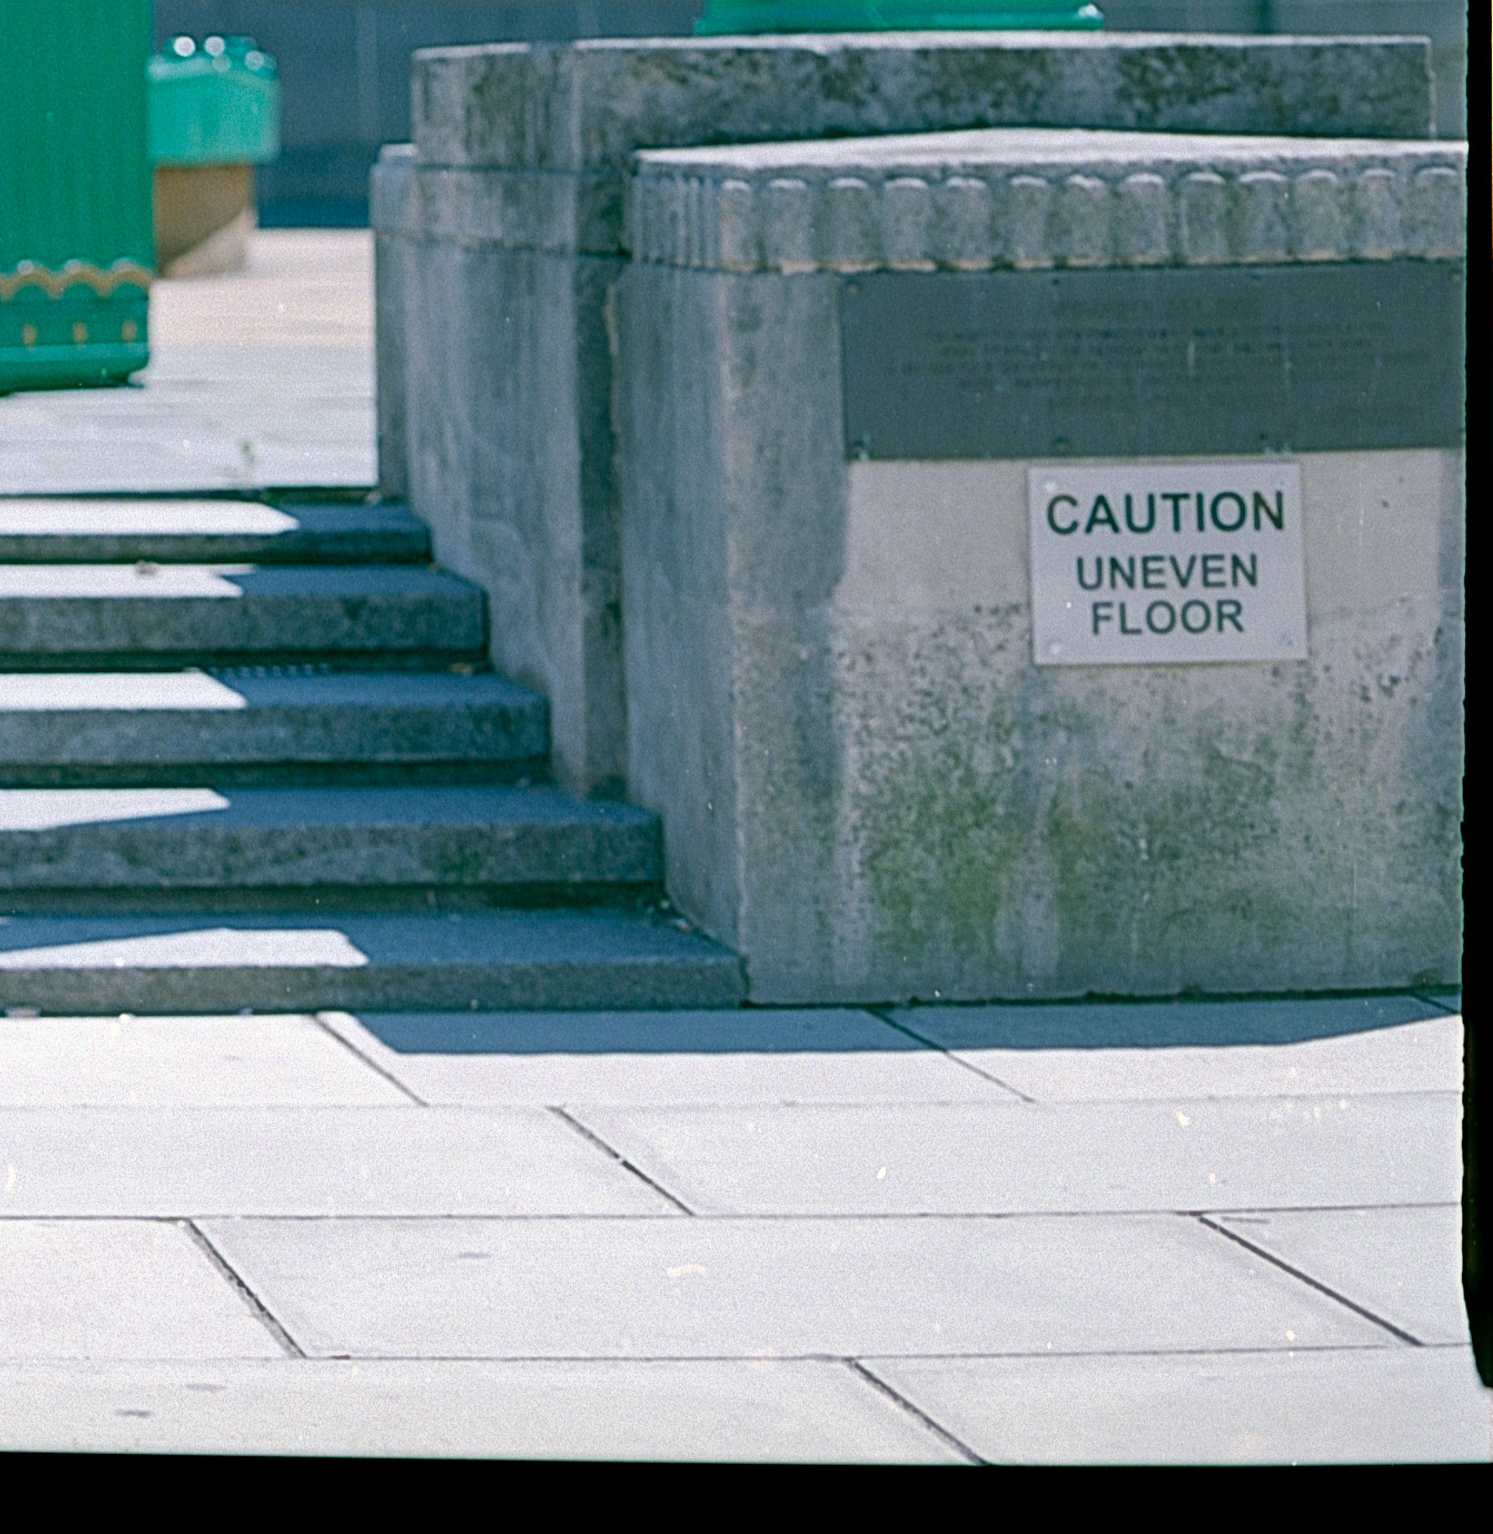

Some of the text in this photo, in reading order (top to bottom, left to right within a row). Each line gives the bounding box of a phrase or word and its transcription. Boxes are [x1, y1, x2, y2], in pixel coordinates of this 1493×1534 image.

[1047, 490, 1285, 535] CAUTION
[1076, 553, 1258, 591] UNEVEN
[1091, 598, 1245, 635] FLOOR
